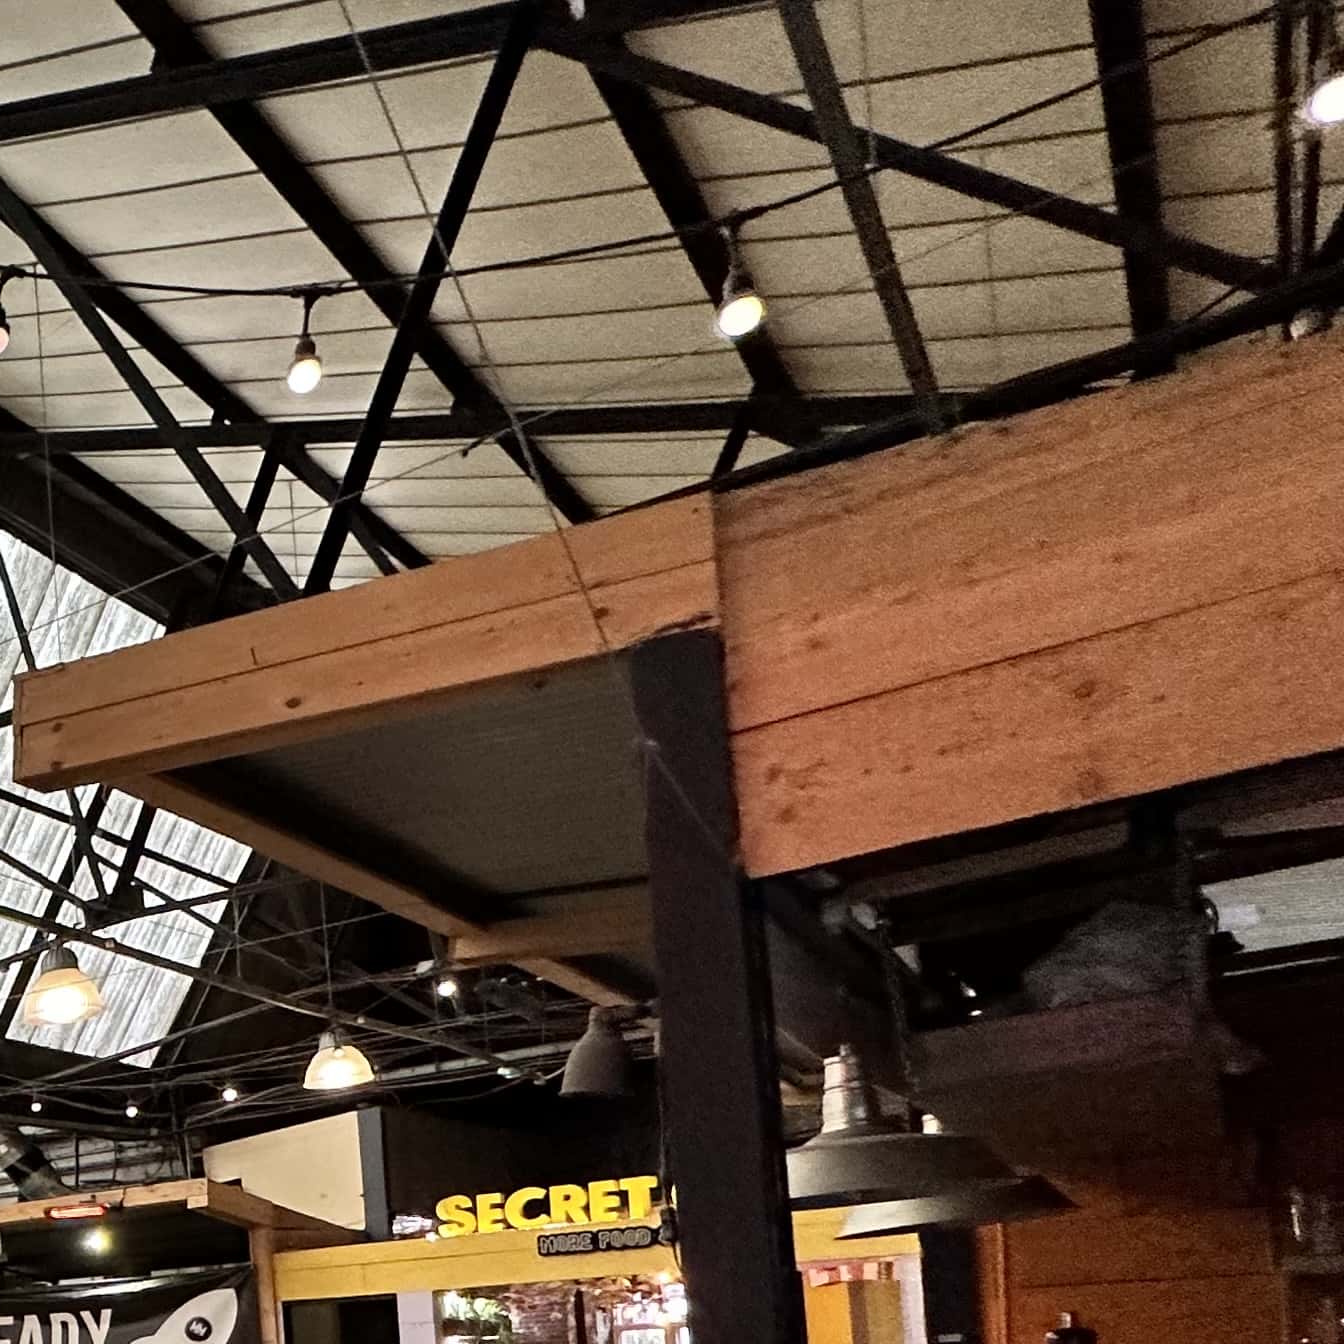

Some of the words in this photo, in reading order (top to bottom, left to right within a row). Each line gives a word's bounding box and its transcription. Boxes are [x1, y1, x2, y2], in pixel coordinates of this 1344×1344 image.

[435, 1174, 658, 1238] SECRET
[539, 1233, 593, 1254] MORE
[598, 1229, 651, 1249] FOOD
